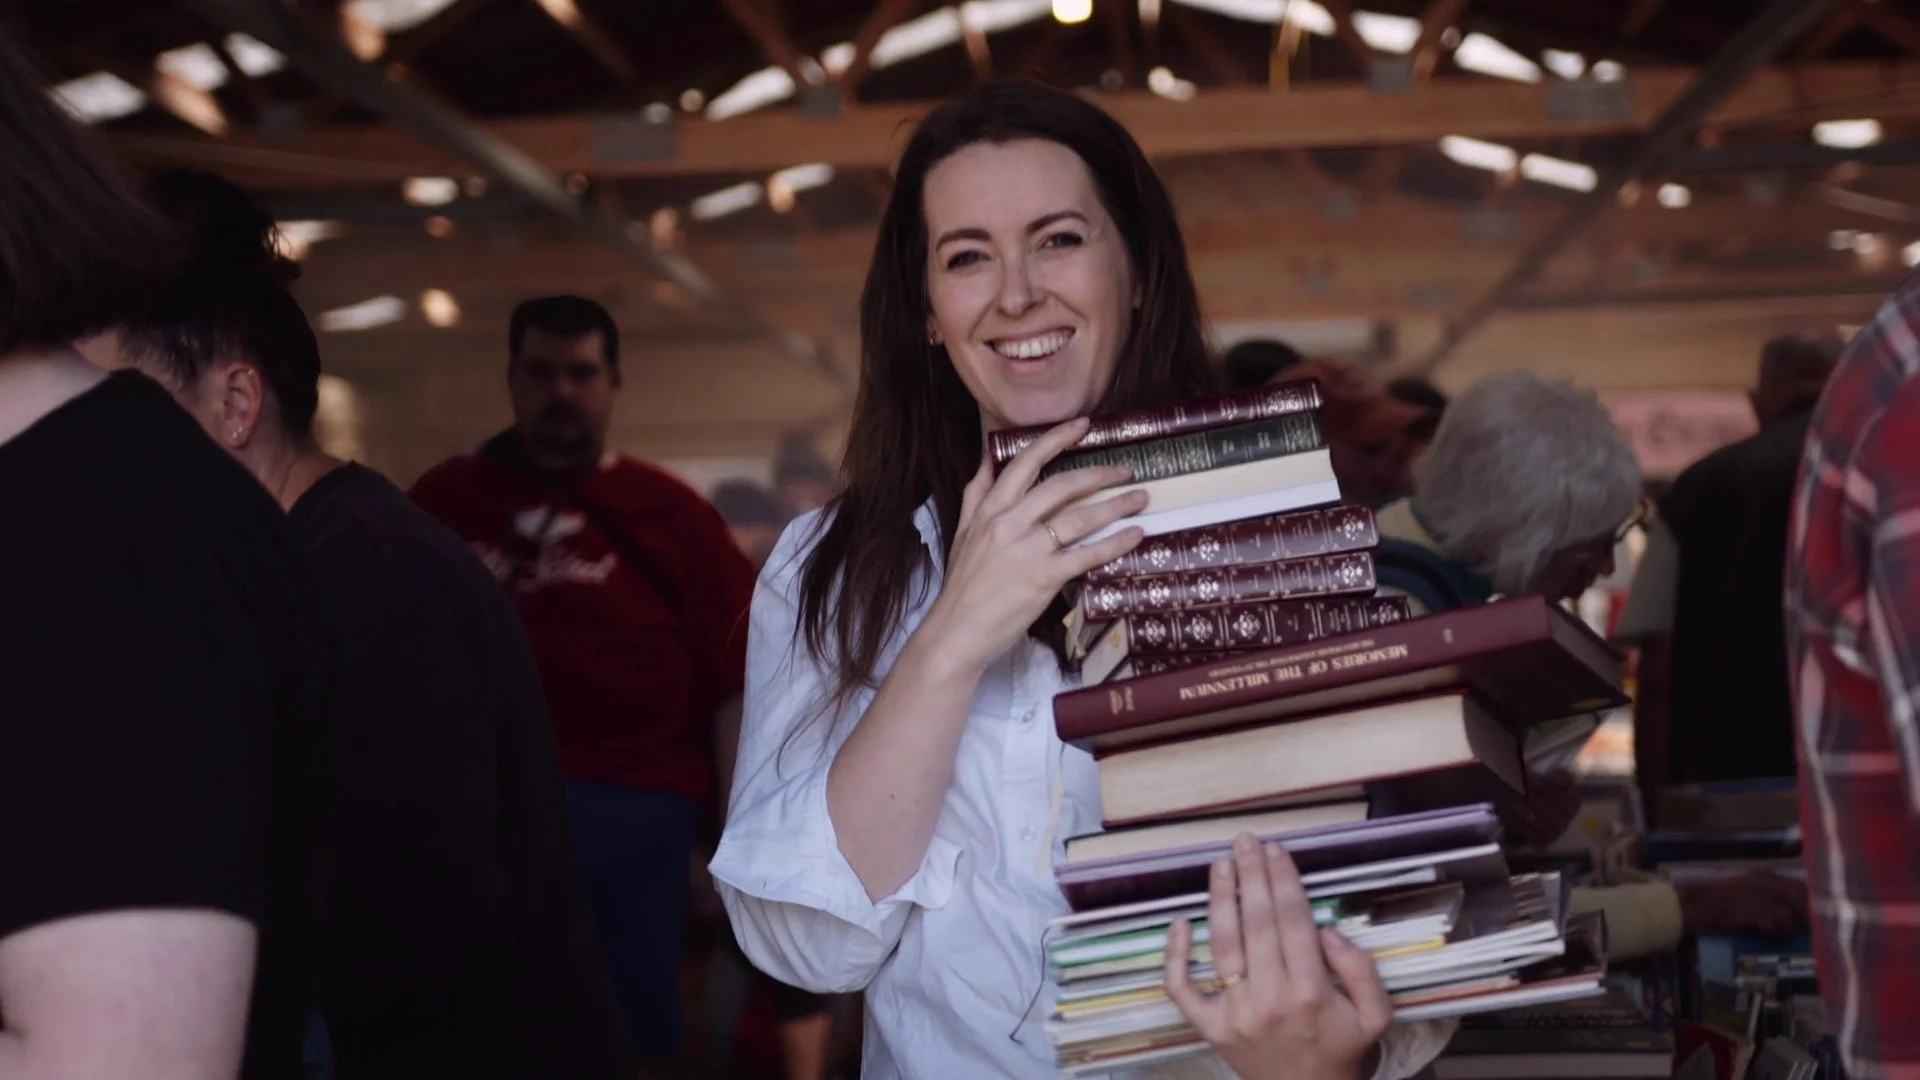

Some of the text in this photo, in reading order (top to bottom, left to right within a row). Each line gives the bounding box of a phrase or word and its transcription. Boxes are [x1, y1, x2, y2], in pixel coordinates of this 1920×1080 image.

[1308, 660, 1327, 675] OF
[1332, 643, 1408, 670] MEMORIES
[1276, 664, 1303, 682] THE
[1179, 672, 1270, 700] MILLENNIUM
